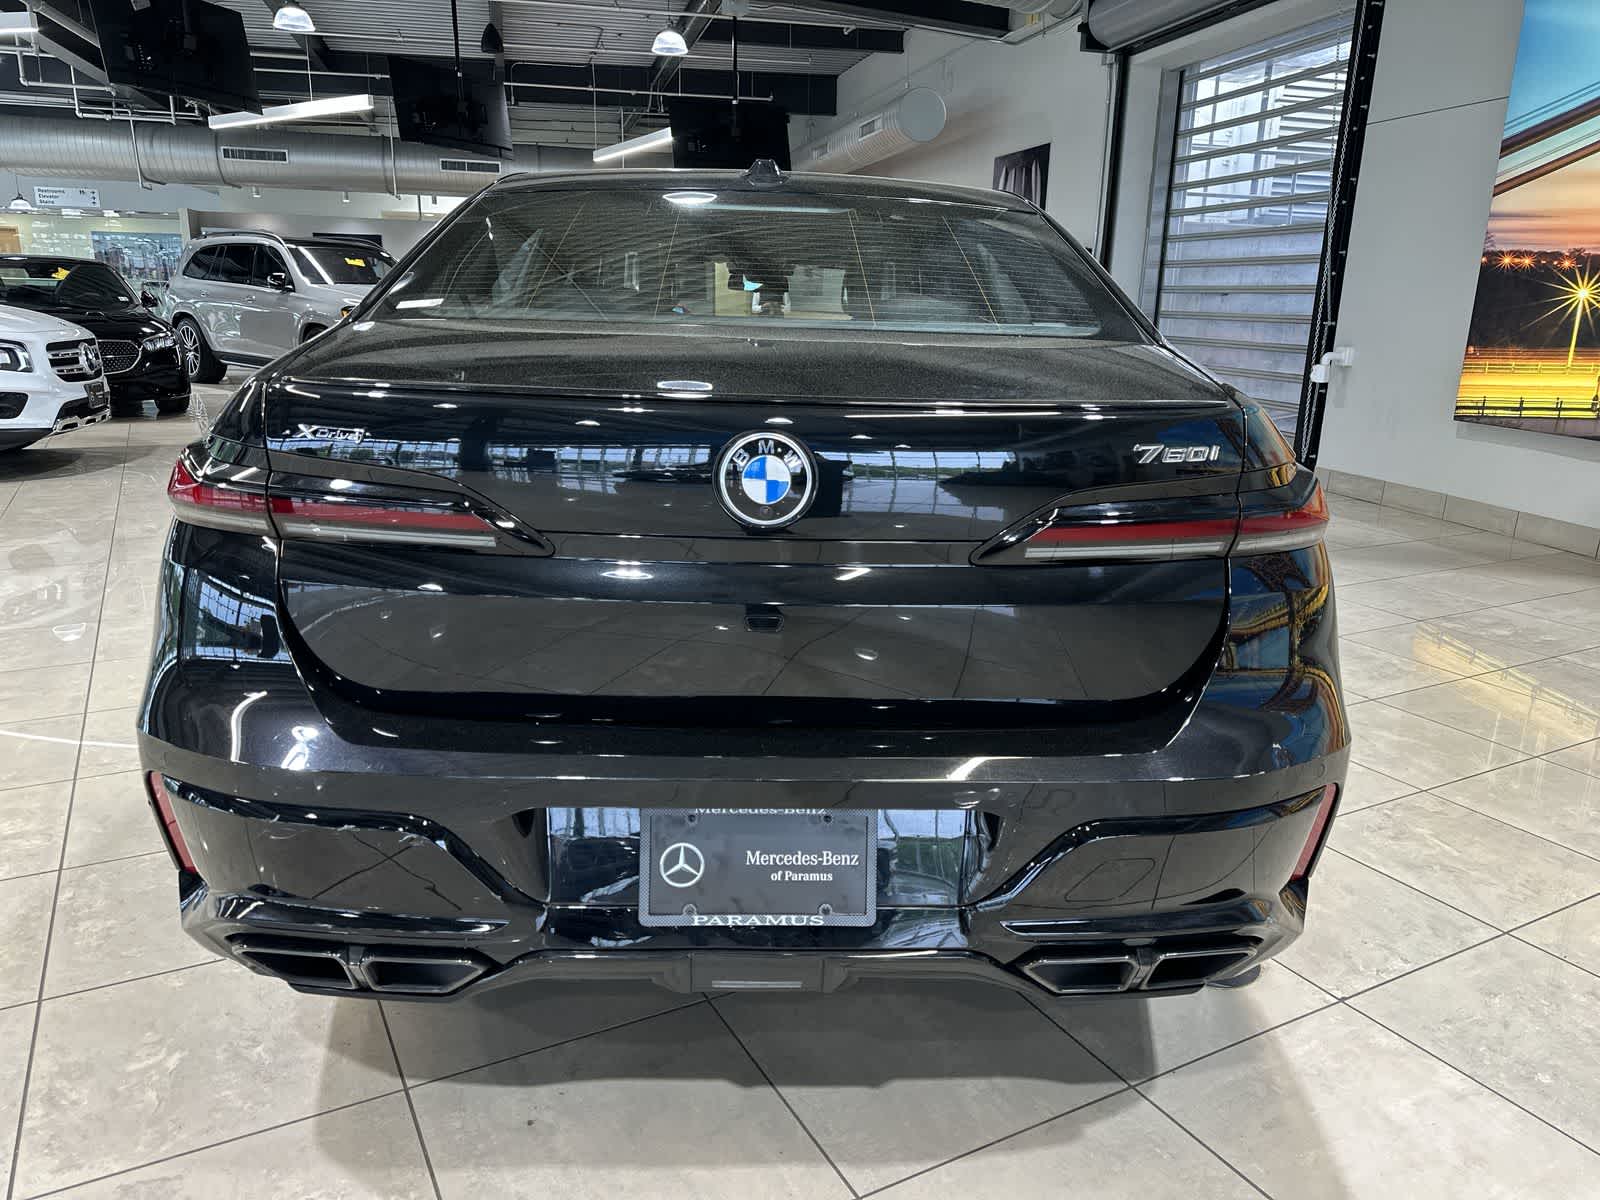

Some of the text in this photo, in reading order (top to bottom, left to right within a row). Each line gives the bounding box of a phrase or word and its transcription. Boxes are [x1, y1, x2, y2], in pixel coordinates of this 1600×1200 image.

[731, 439, 804, 473] BMW
[746, 850, 859, 866] Mercedes-Benz
[770, 870, 833, 881] of Paramus
[691, 914, 825, 926] PARAMUS
